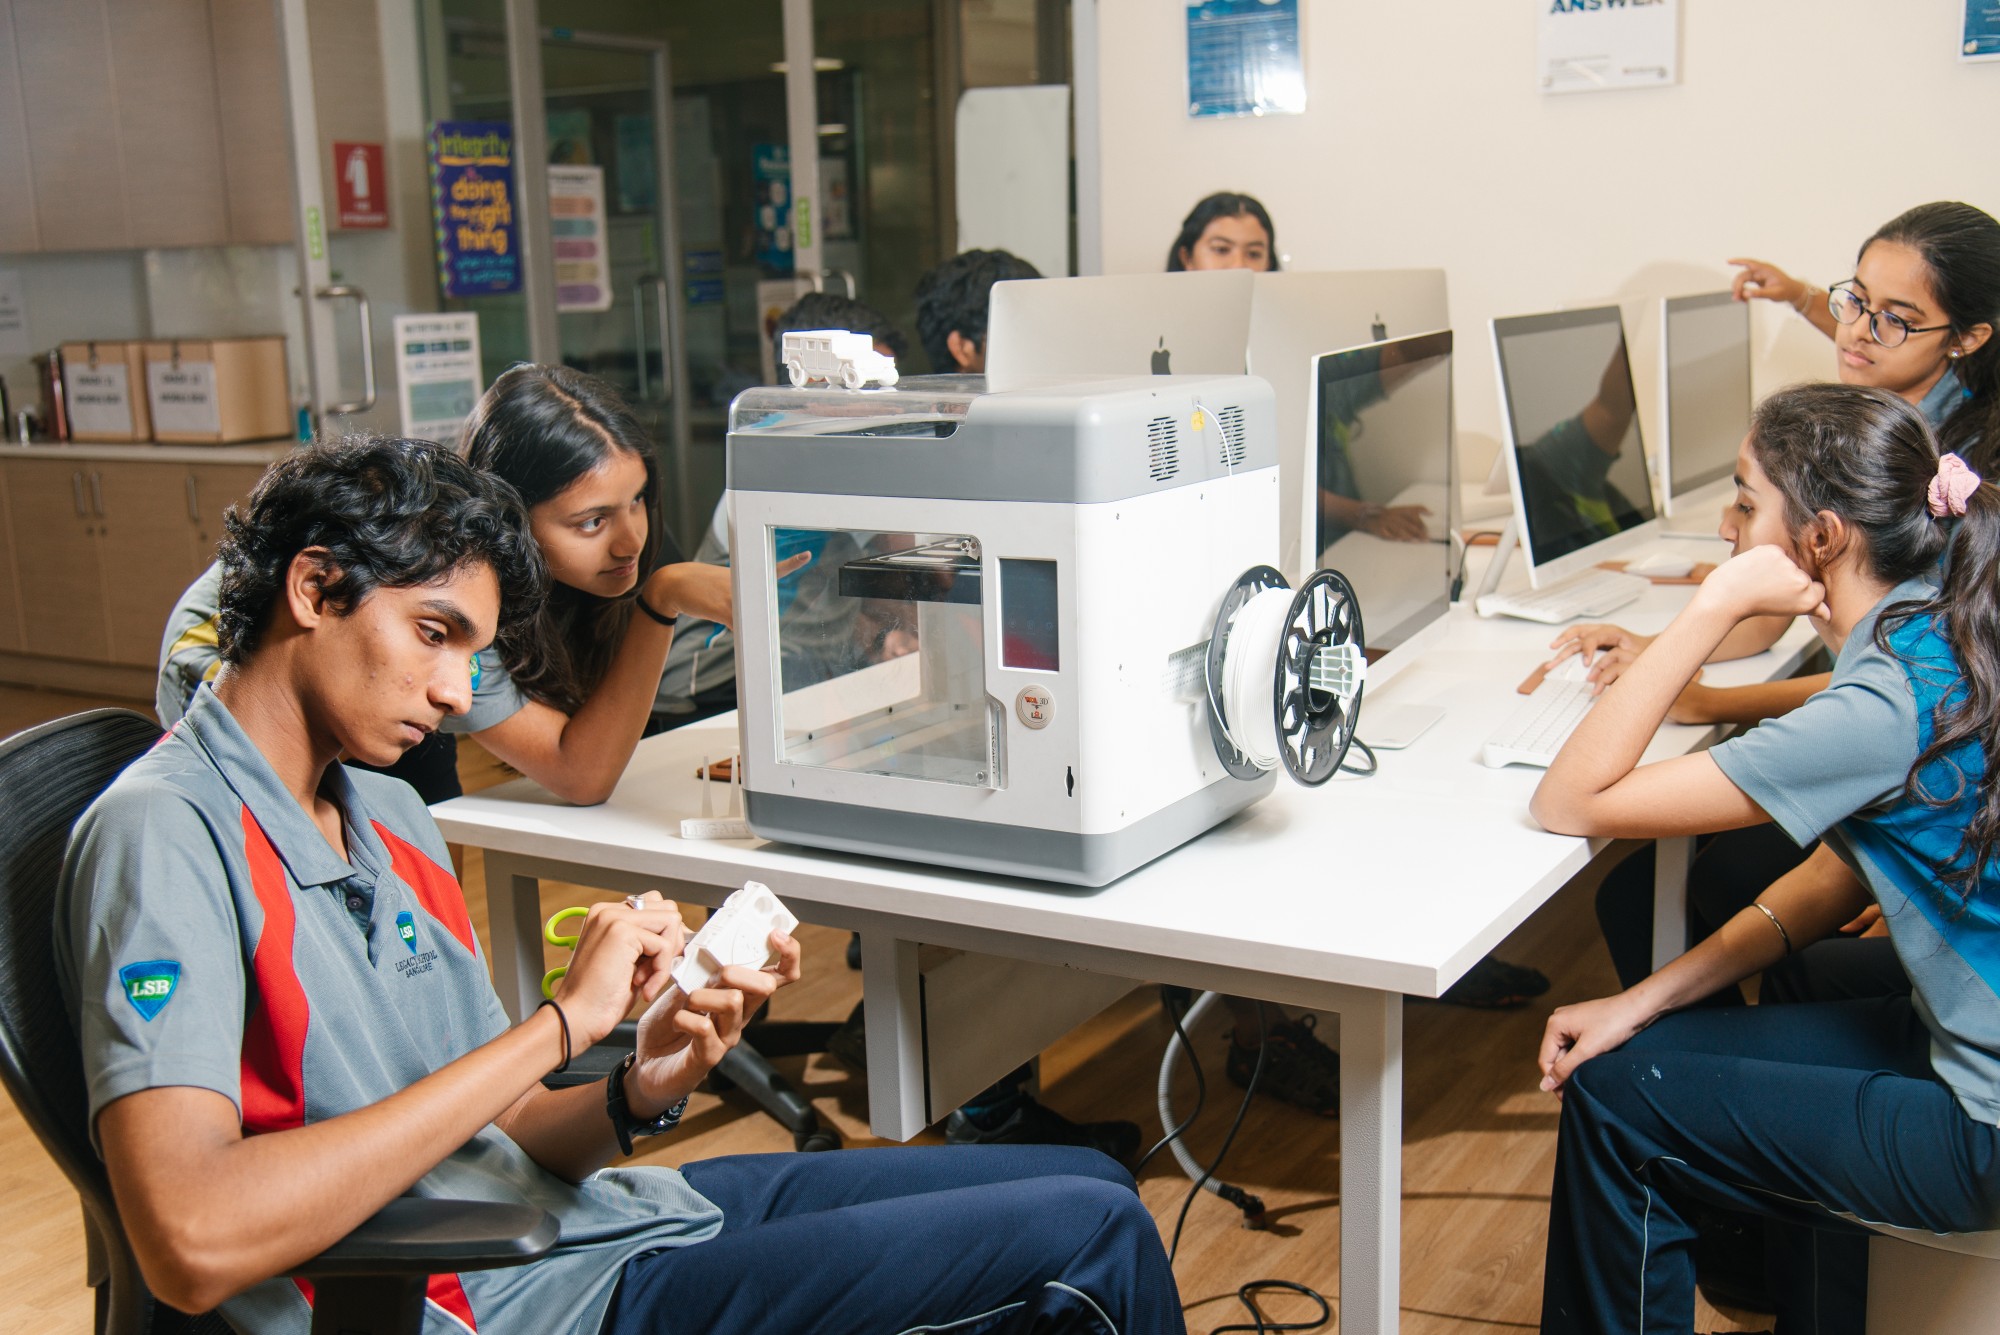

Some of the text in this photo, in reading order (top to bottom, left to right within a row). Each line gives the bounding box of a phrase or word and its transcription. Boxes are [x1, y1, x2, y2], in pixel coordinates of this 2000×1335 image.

[1549, 0, 1666, 15] ANSW
[451, 177, 506, 207] doing
[468, 202, 512, 232] right
[457, 224, 508, 255] thing
[400, 925, 414, 938] LSB
[395, 950, 437, 972] LEGACY SCHOOL
[132, 979, 170, 997] LSB
